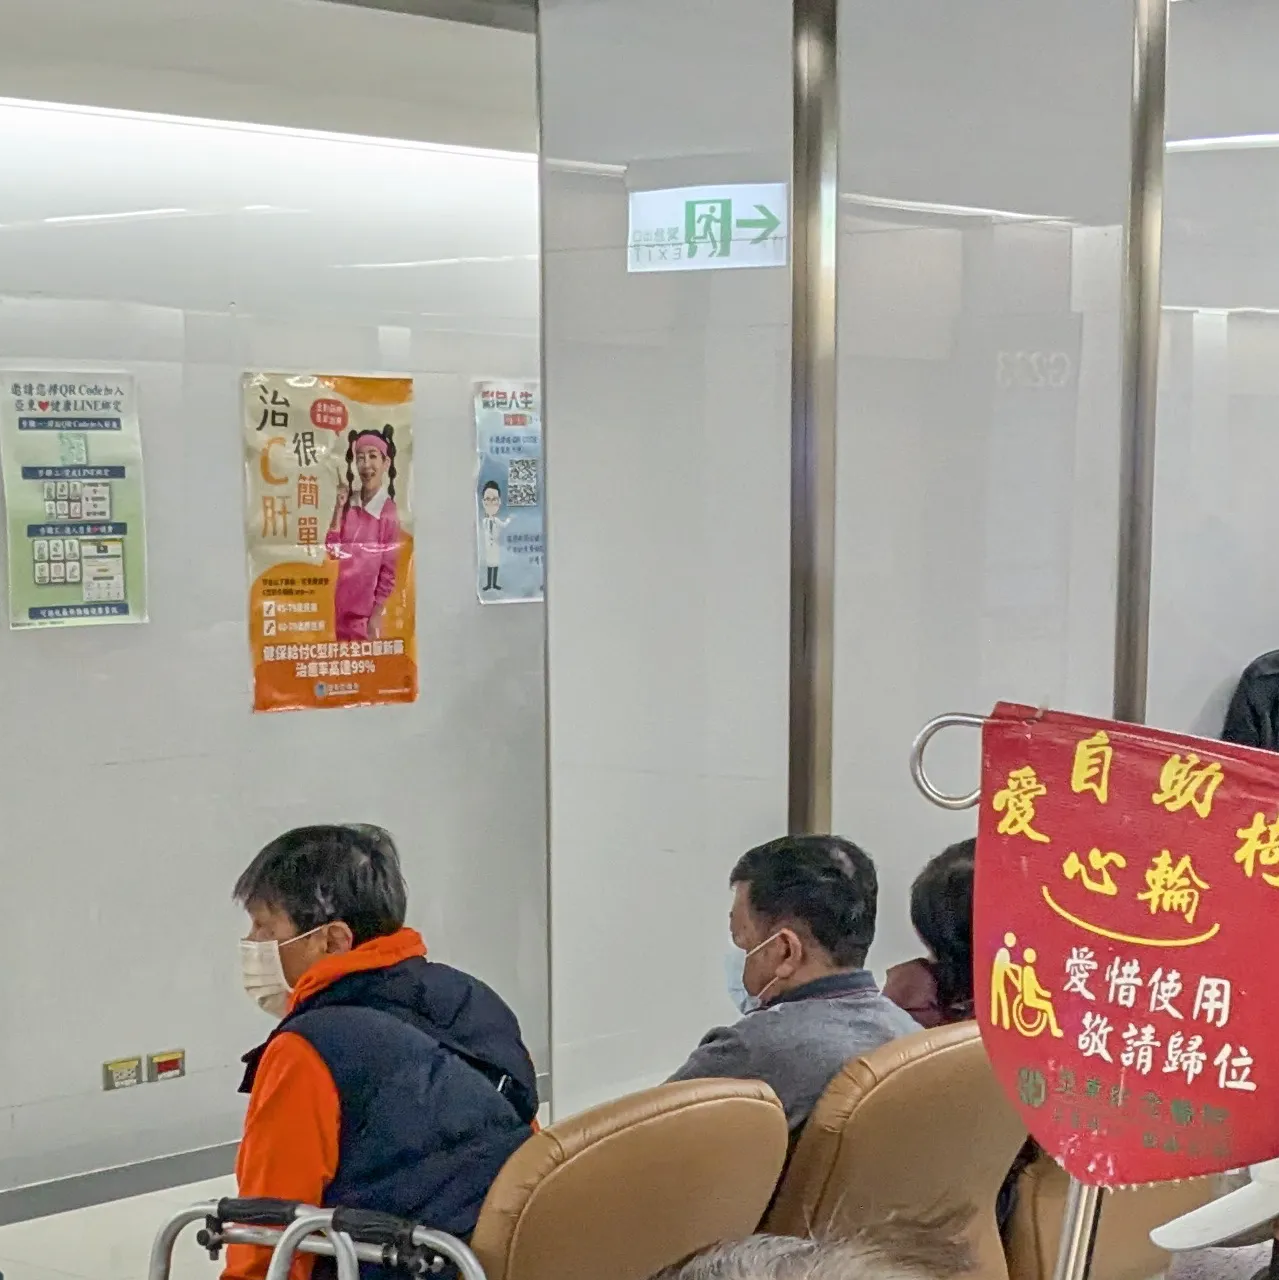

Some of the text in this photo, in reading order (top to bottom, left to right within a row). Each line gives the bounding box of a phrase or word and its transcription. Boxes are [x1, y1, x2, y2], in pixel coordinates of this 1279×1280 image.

[1062, 946, 1233, 1028] 愛惜使用
[1076, 1011, 1258, 1092] 敬請歸位
